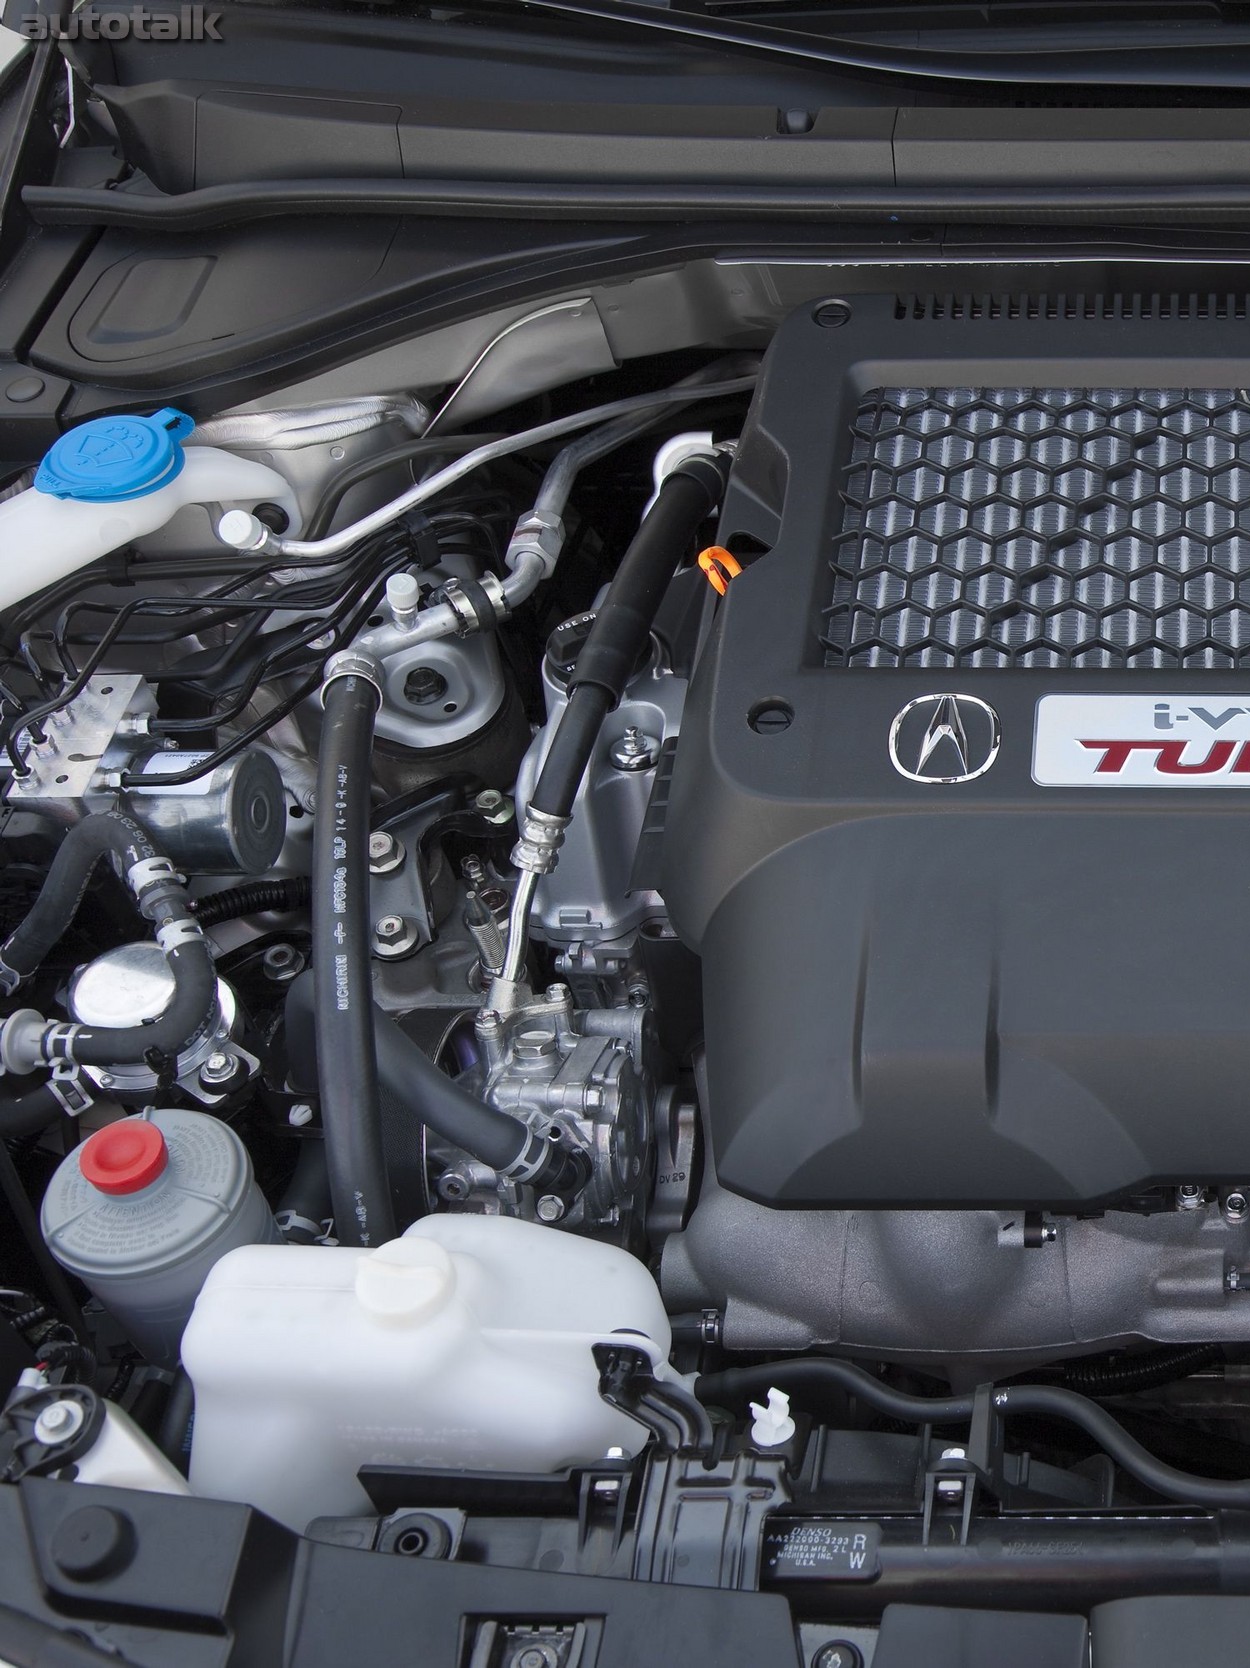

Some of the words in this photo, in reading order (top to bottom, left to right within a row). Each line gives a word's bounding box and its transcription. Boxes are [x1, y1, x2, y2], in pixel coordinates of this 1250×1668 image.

[557, 621, 578, 631] USE
[335, 954, 349, 1010] NICHIRIN
[791, 1527, 832, 1537] DENSO
[853, 1534, 866, 1550] R
[849, 1552, 866, 1568] W
